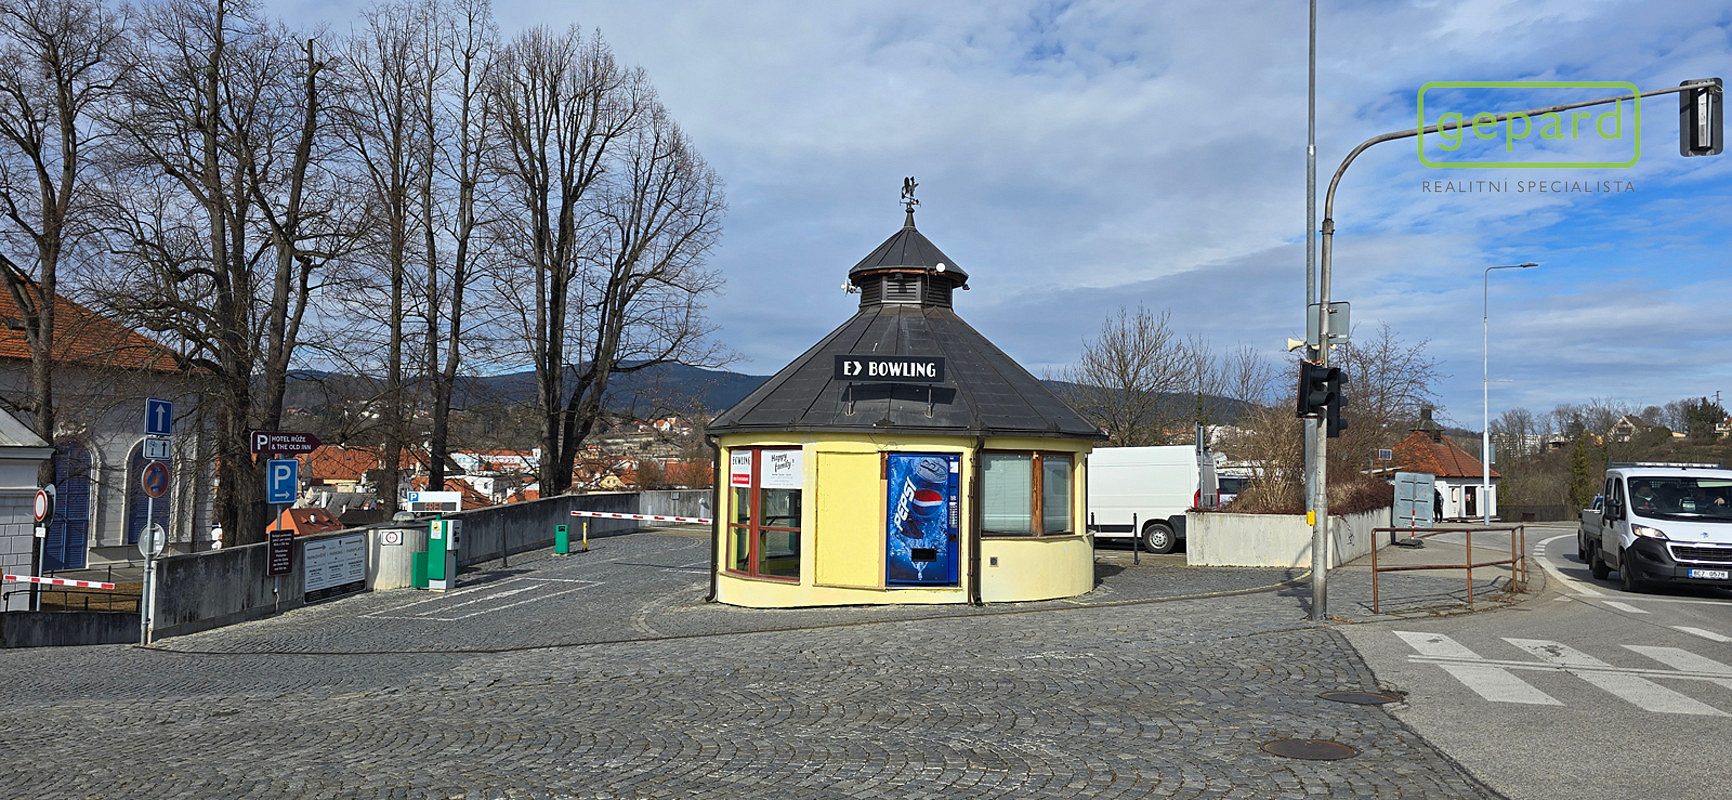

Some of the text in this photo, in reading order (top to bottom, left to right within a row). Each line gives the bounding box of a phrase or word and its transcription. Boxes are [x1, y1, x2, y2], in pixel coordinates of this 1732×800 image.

[868, 361, 937, 378] BOWLING
[257, 434, 268, 450] P
[271, 435, 290, 443] HOTEL
[274, 465, 291, 490] P
[410, 493, 417, 501] P
[894, 476, 917, 531] PEPSI
